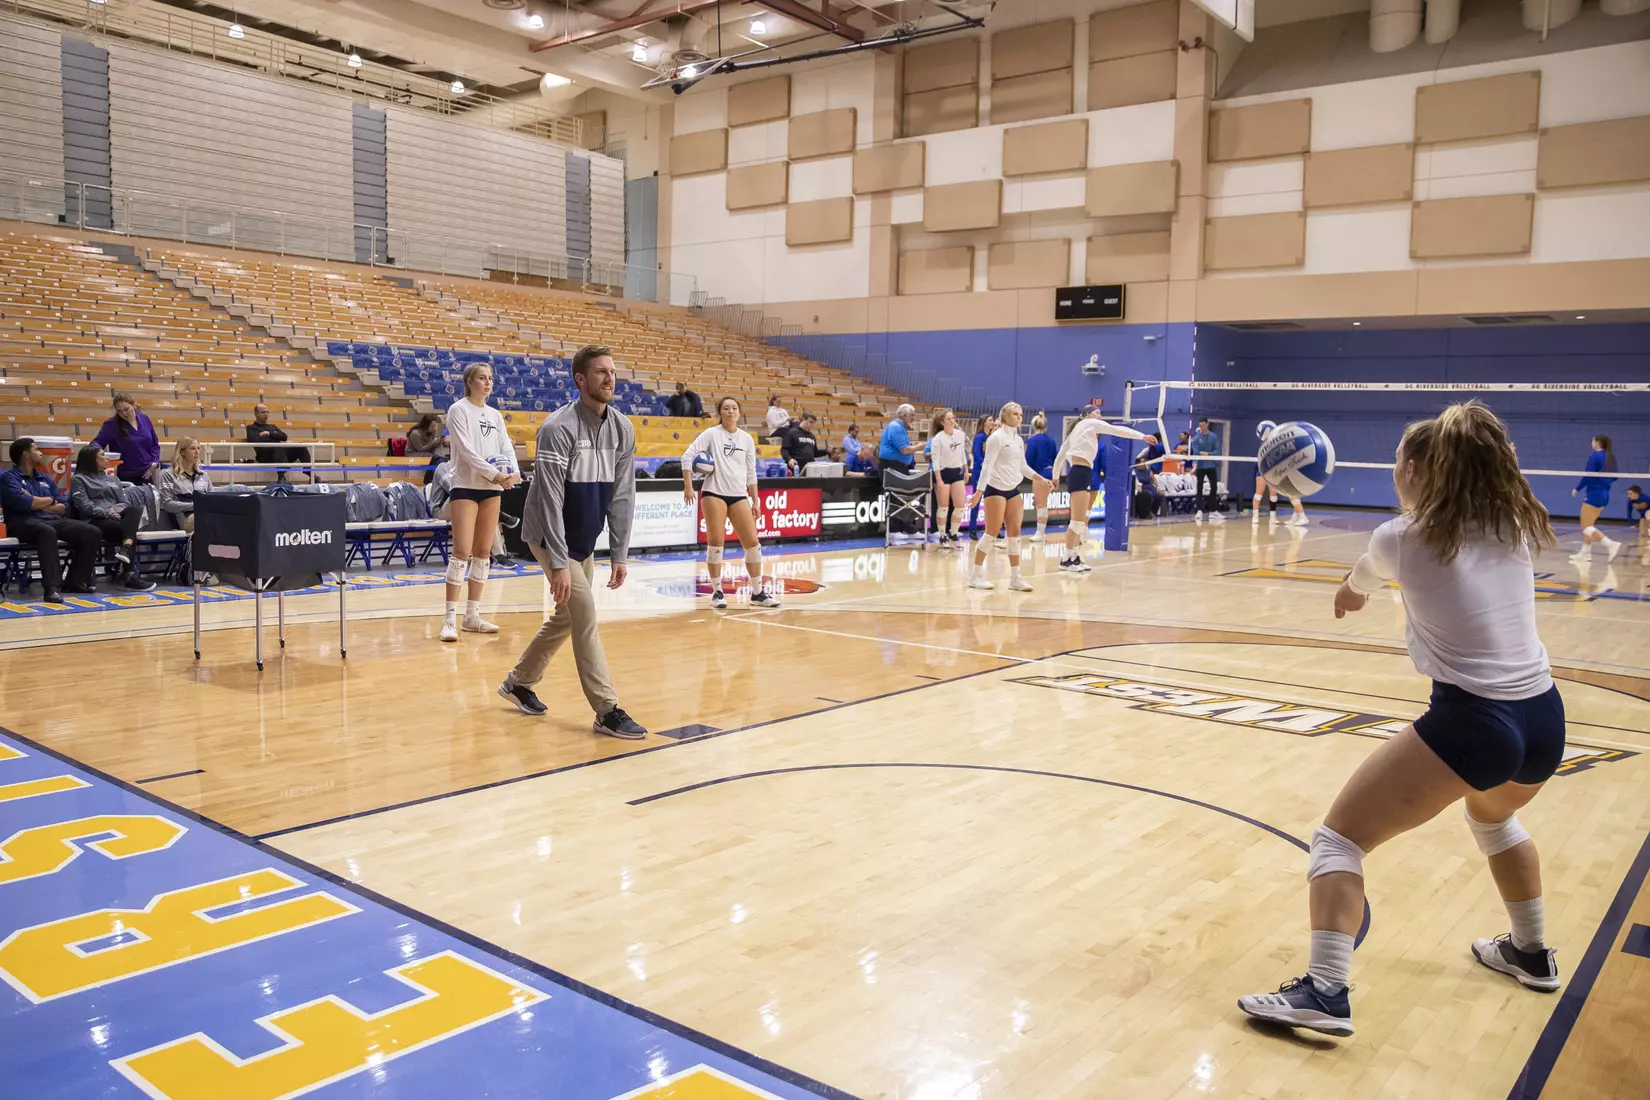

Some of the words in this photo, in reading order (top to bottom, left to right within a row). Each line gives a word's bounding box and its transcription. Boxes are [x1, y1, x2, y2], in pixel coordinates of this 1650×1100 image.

[635, 503, 671, 511] WELCOME
[765, 490, 787, 510] old
[635, 511, 670, 520] IFFERENT
[671, 510, 693, 518] PLACE
[771, 509, 819, 530] factory
[275, 529, 332, 547] molten
